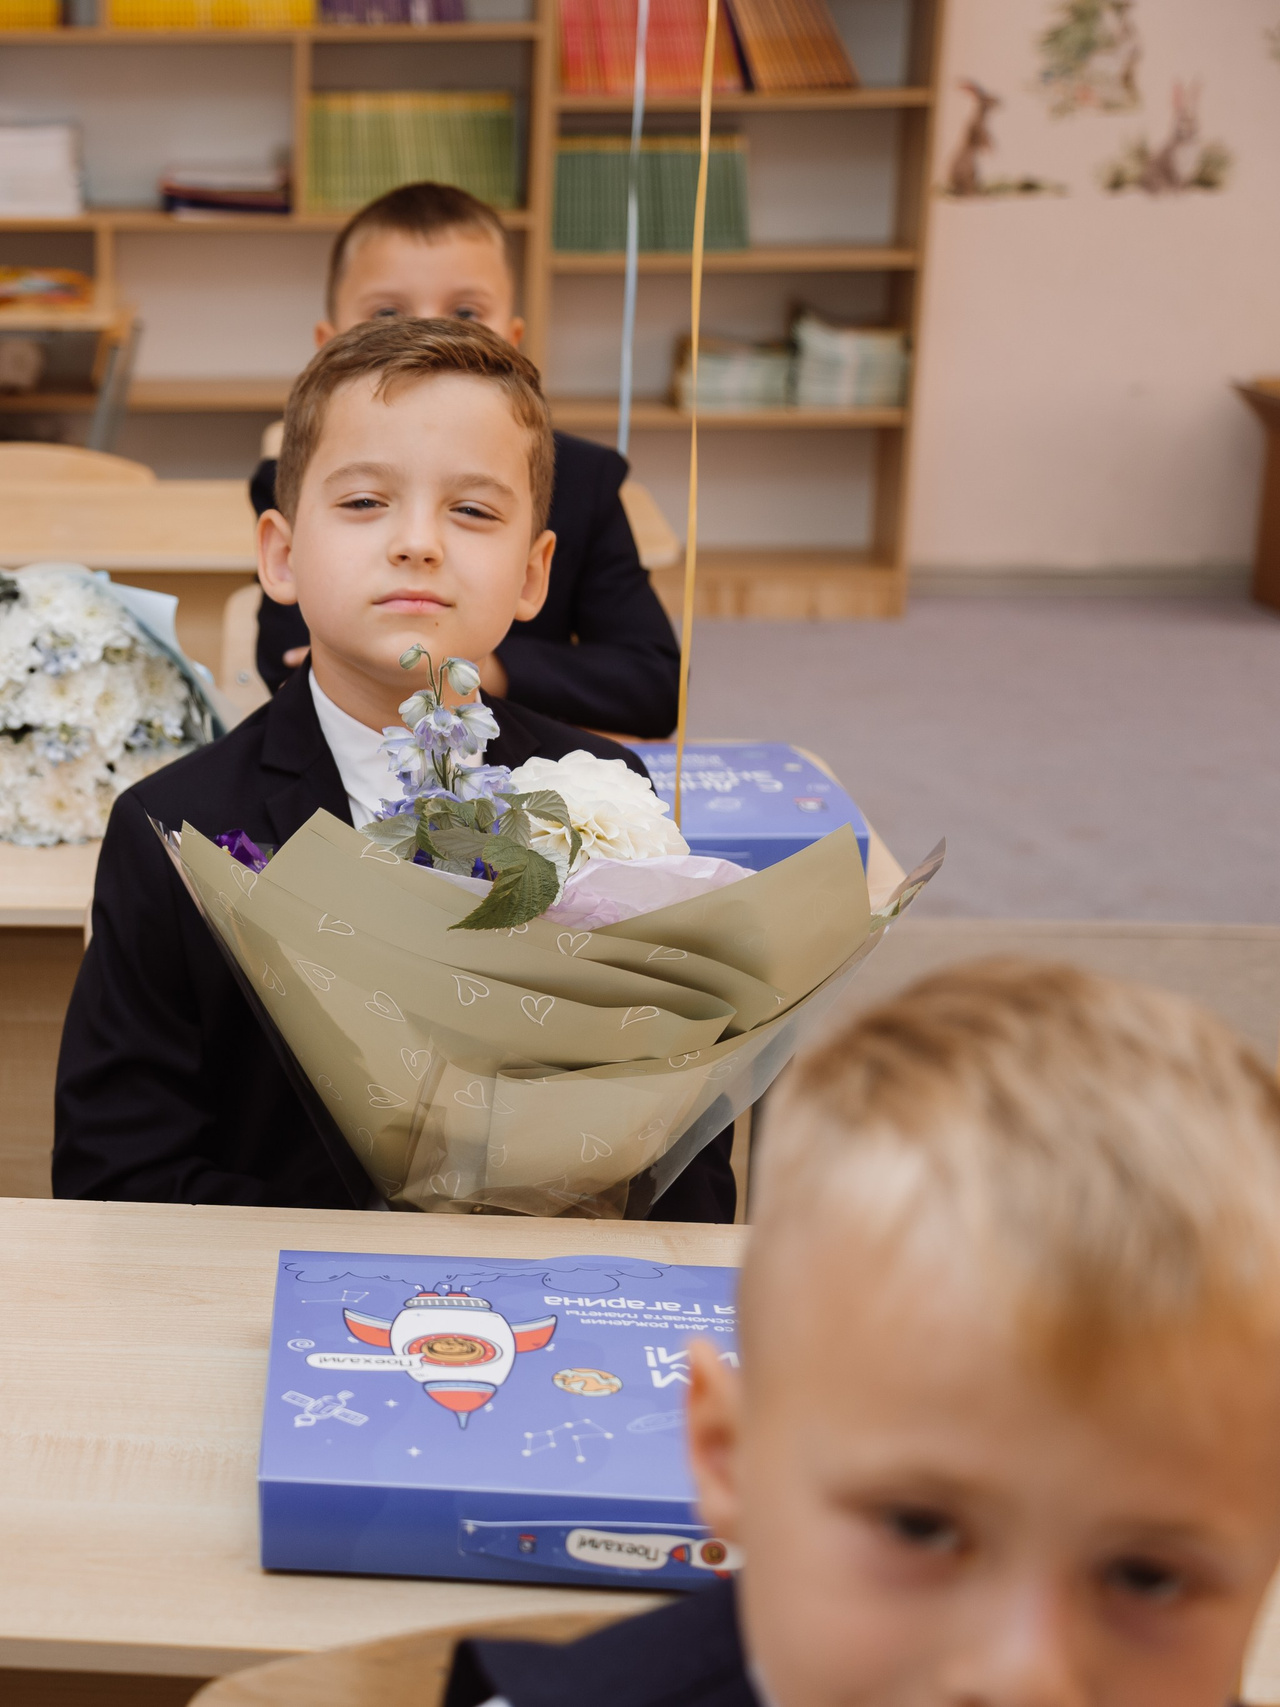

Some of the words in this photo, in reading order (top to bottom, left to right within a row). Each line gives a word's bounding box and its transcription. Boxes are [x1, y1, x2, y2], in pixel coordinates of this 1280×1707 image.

[543, 1295, 702, 1315] Гагарина
[565, 1309, 639, 1320] планеты
[642, 1312, 736, 1325] осмонавта
[580, 1318, 670, 1329] рождения
[673, 1322, 709, 1332] дня
[319, 1355, 414, 1367] Поехали!
[578, 1534, 660, 1562] Поехали!
